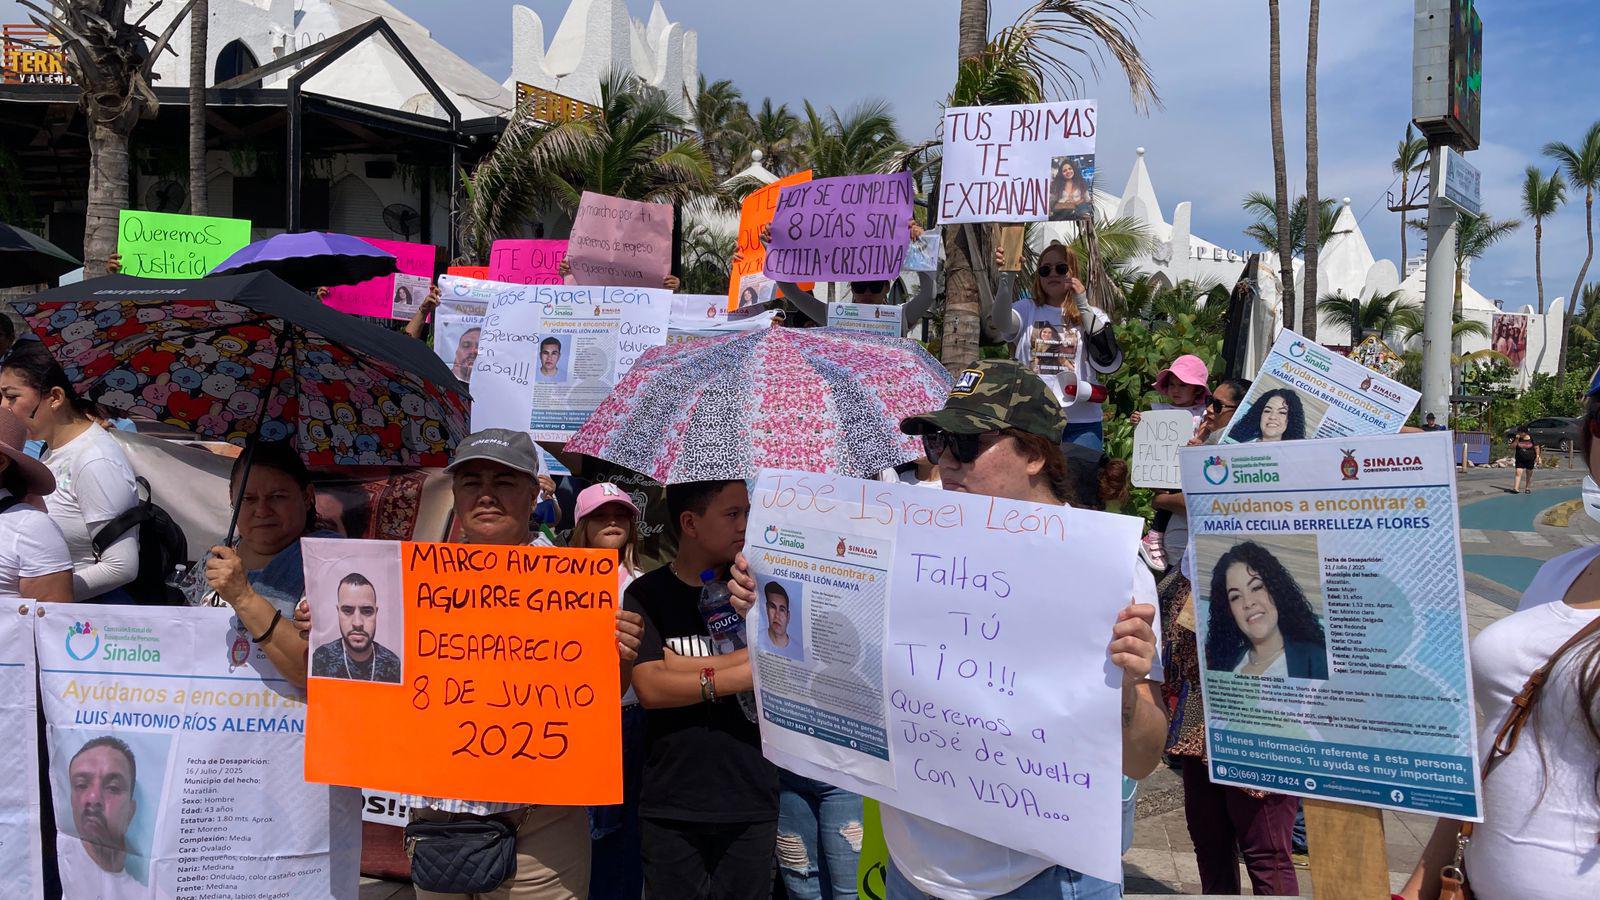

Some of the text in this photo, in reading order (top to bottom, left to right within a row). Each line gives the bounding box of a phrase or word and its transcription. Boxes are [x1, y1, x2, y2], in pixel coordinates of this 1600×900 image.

[11, 51, 63, 74] TERR
[947, 108, 1095, 142] TUS PRIMAS
[976, 144, 1011, 176] TE
[777, 179, 910, 212] HOY SE CUMPLEN
[942, 177, 1048, 218] EXTRAÑAN
[620, 210, 632, 222] por
[788, 208, 897, 240] 8 DÍAS SIN
[495, 249, 567, 270] TE QUE
[613, 242, 620, 251] de
[766, 248, 821, 275] CECILIA
[831, 245, 903, 274] CRISTINA
[493, 287, 651, 310] José Israel León
[620, 322, 660, 335] Quiero
[1304, 354, 1330, 373] Sinaloa
[1272, 368, 1295, 384] MARÍA
[1295, 381, 1320, 397] CECILIA
[1320, 392, 1360, 417] BERRELLEZA
[1361, 411, 1387, 429] FLORES
[1282, 361, 1328, 389] Ayúdanos
[1329, 385, 1336, 393] a
[1337, 391, 1381, 416] encontrar
[1373, 385, 1401, 401] SINALOA
[1147, 416, 1178, 441] NOS
[1363, 456, 1422, 467] SINALOA
[1233, 469, 1280, 484] Sinaloa
[762, 474, 1066, 542] José Israel León
[1211, 496, 1426, 516] Ayúdanos a encontrar a
[1204, 517, 1430, 531] MARÍA CECILIA BERRELLEZA FLORES
[779, 537, 805, 549] Sinaloa
[848, 545, 878, 556] SINALOA
[410, 544, 614, 575] MARCO ANTONIO
[763, 552, 875, 582] Ayúdanos a encontrar a
[773, 568, 860, 592] JOSÉ ISRAEL LEÓN AMAYA
[911, 553, 1011, 598] Faltas
[417, 582, 613, 613] AGUIRRE GARCIA
[948, 610, 1001, 641] TÚ
[103, 643, 161, 662] Sinaloa
[418, 629, 582, 662] DESAPARECIO
[173, 691, 185, 704] a
[412, 675, 594, 710] 8 DE JUNIO
[75, 710, 304, 733] LUIS ANTONIO RÍOS ALEMÁN
[891, 689, 1012, 738] Queremos
[1032, 727, 1046, 744] a
[452, 721, 569, 760] 2025
[1214, 733, 1222, 741] Si
[1227, 735, 1254, 746] tienes
[1258, 740, 1316, 754] información
[1321, 748, 1368, 761] referente
[1385, 754, 1409, 765] esta
[1415, 758, 1466, 772] persona,
[187, 757, 206, 765] Fecha
[899, 720, 1091, 790] José de vuelta
[1215, 744, 1238, 755] llama
[1307, 757, 1319, 766] Tu
[1323, 760, 1354, 771] ayuda
[1358, 765, 1370, 773] es
[1374, 767, 1397, 778] muy
[1401, 768, 1467, 785] importante.
[185, 777, 221, 785] Municipio
[913, 758, 956, 789] Con
[1239, 770, 1299, 786] (669) 327 8424
